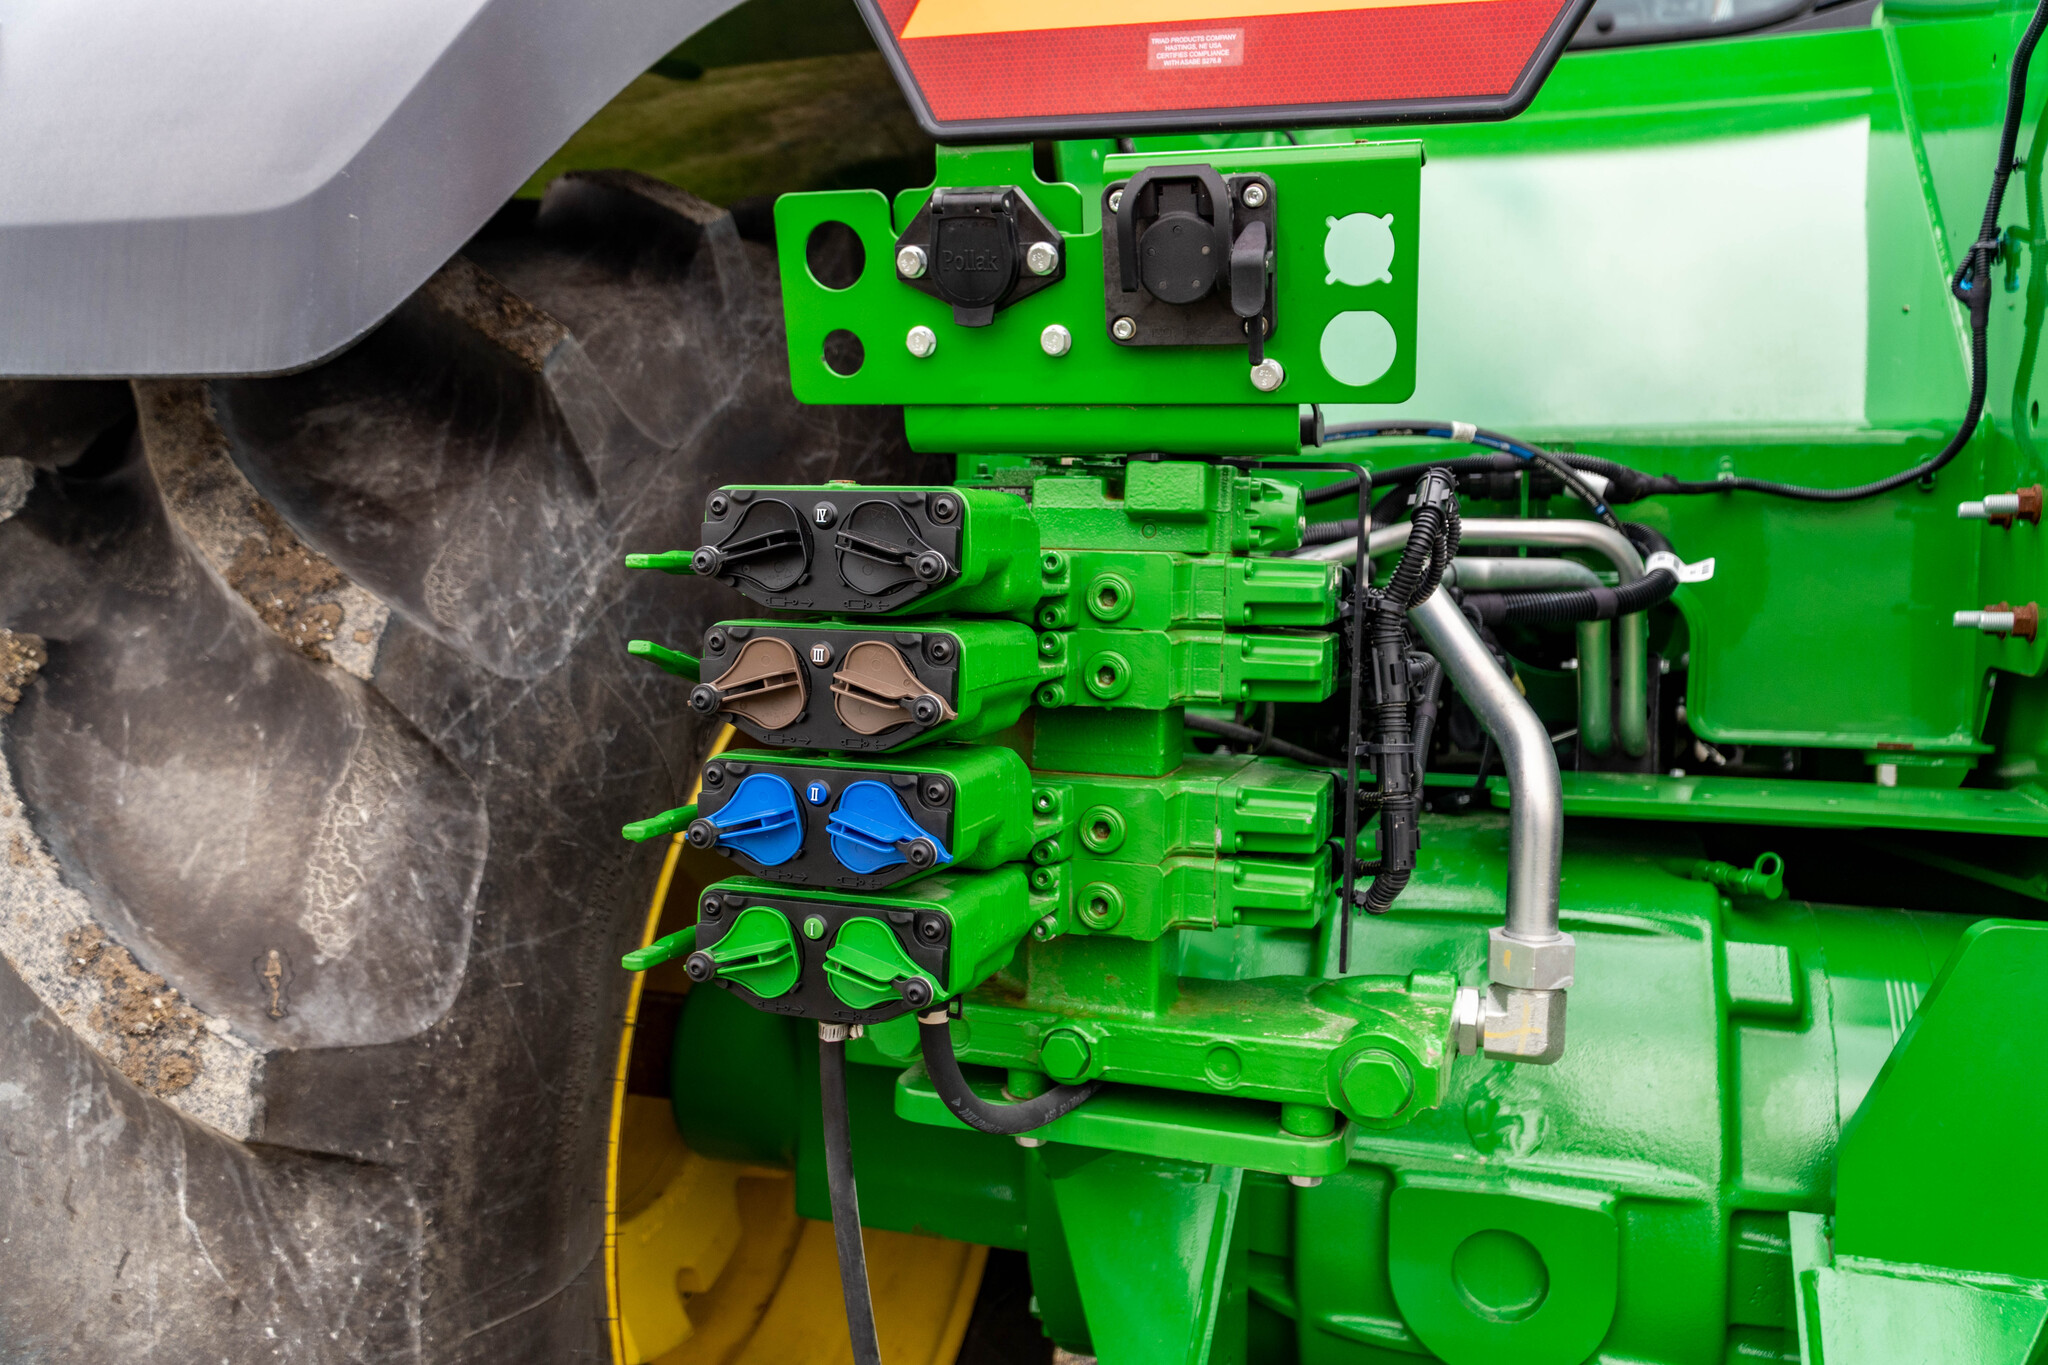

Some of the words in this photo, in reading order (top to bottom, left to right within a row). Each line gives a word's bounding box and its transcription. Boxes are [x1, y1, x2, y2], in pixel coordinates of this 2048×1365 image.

[1170, 36, 1204, 44] PRODUCTS
[1206, 34, 1236, 42] COMPANY
[1189, 49, 1230, 58] COMPLIANCE
[942, 249, 999, 272] Pollak
[816, 508, 828, 522] IV
[812, 648, 825, 662] III
[811, 787, 819, 802] II
